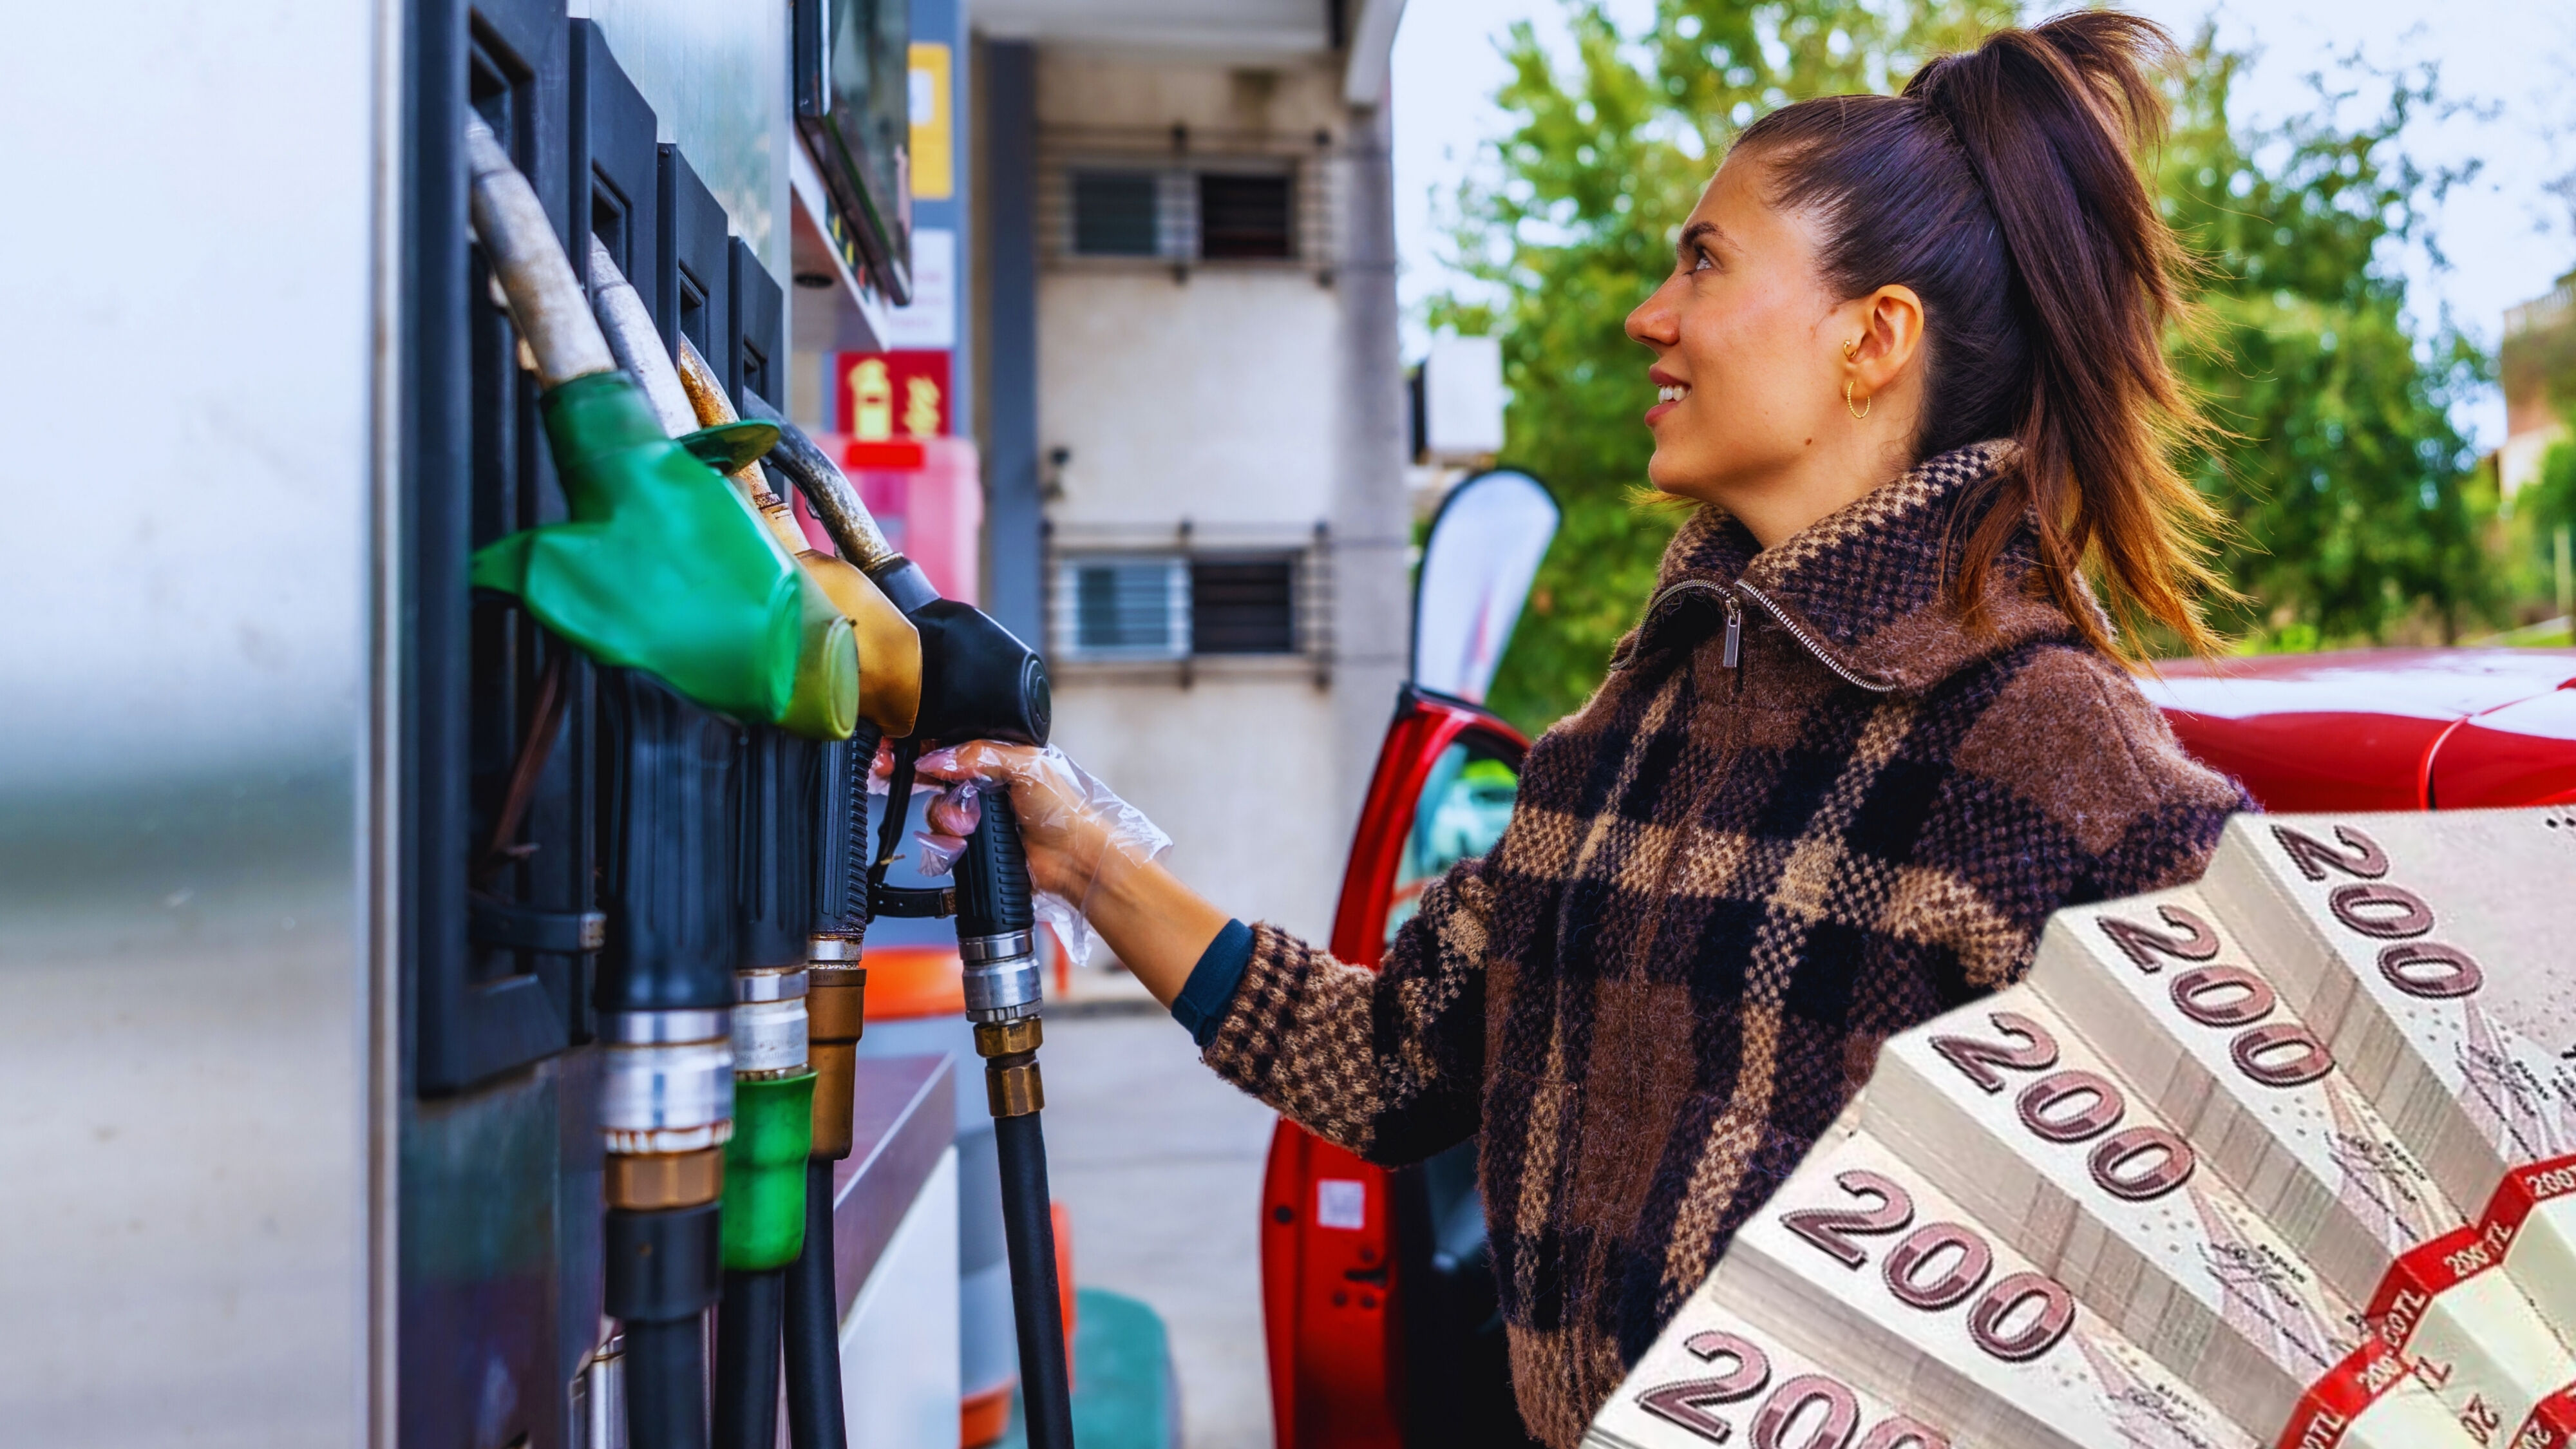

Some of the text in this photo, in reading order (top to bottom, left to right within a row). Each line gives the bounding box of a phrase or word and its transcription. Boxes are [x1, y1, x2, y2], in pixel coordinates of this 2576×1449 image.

[2096, 904, 2336, 1088] 200
[2270, 824, 2485, 999] 200
[1927, 1012, 2195, 1202] 200
[1779, 1170, 2076, 1363] 200
